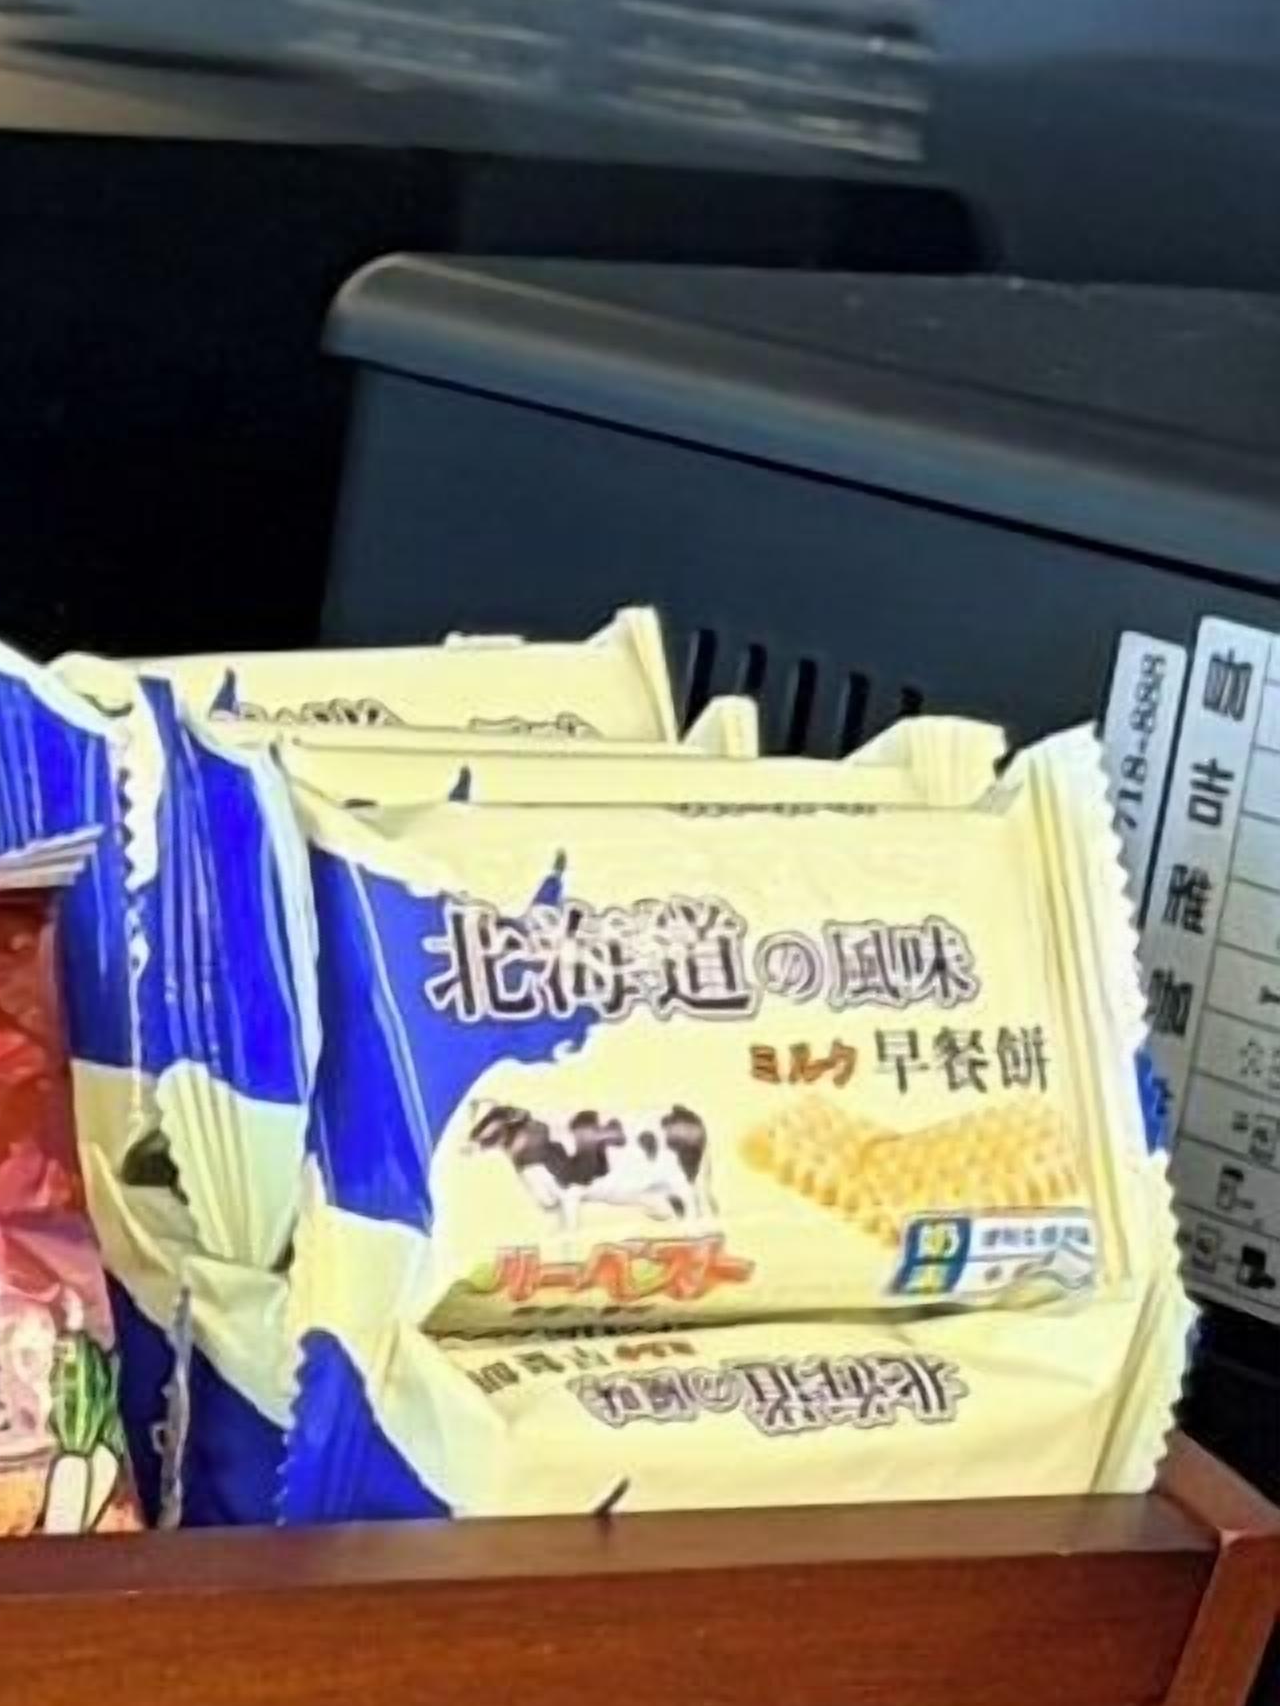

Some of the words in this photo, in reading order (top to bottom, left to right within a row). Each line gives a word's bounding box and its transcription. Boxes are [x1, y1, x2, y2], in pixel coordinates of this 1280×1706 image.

[427, 898, 977, 1020] 北海道の風味
[874, 1024, 1050, 1093] 早餐餅
